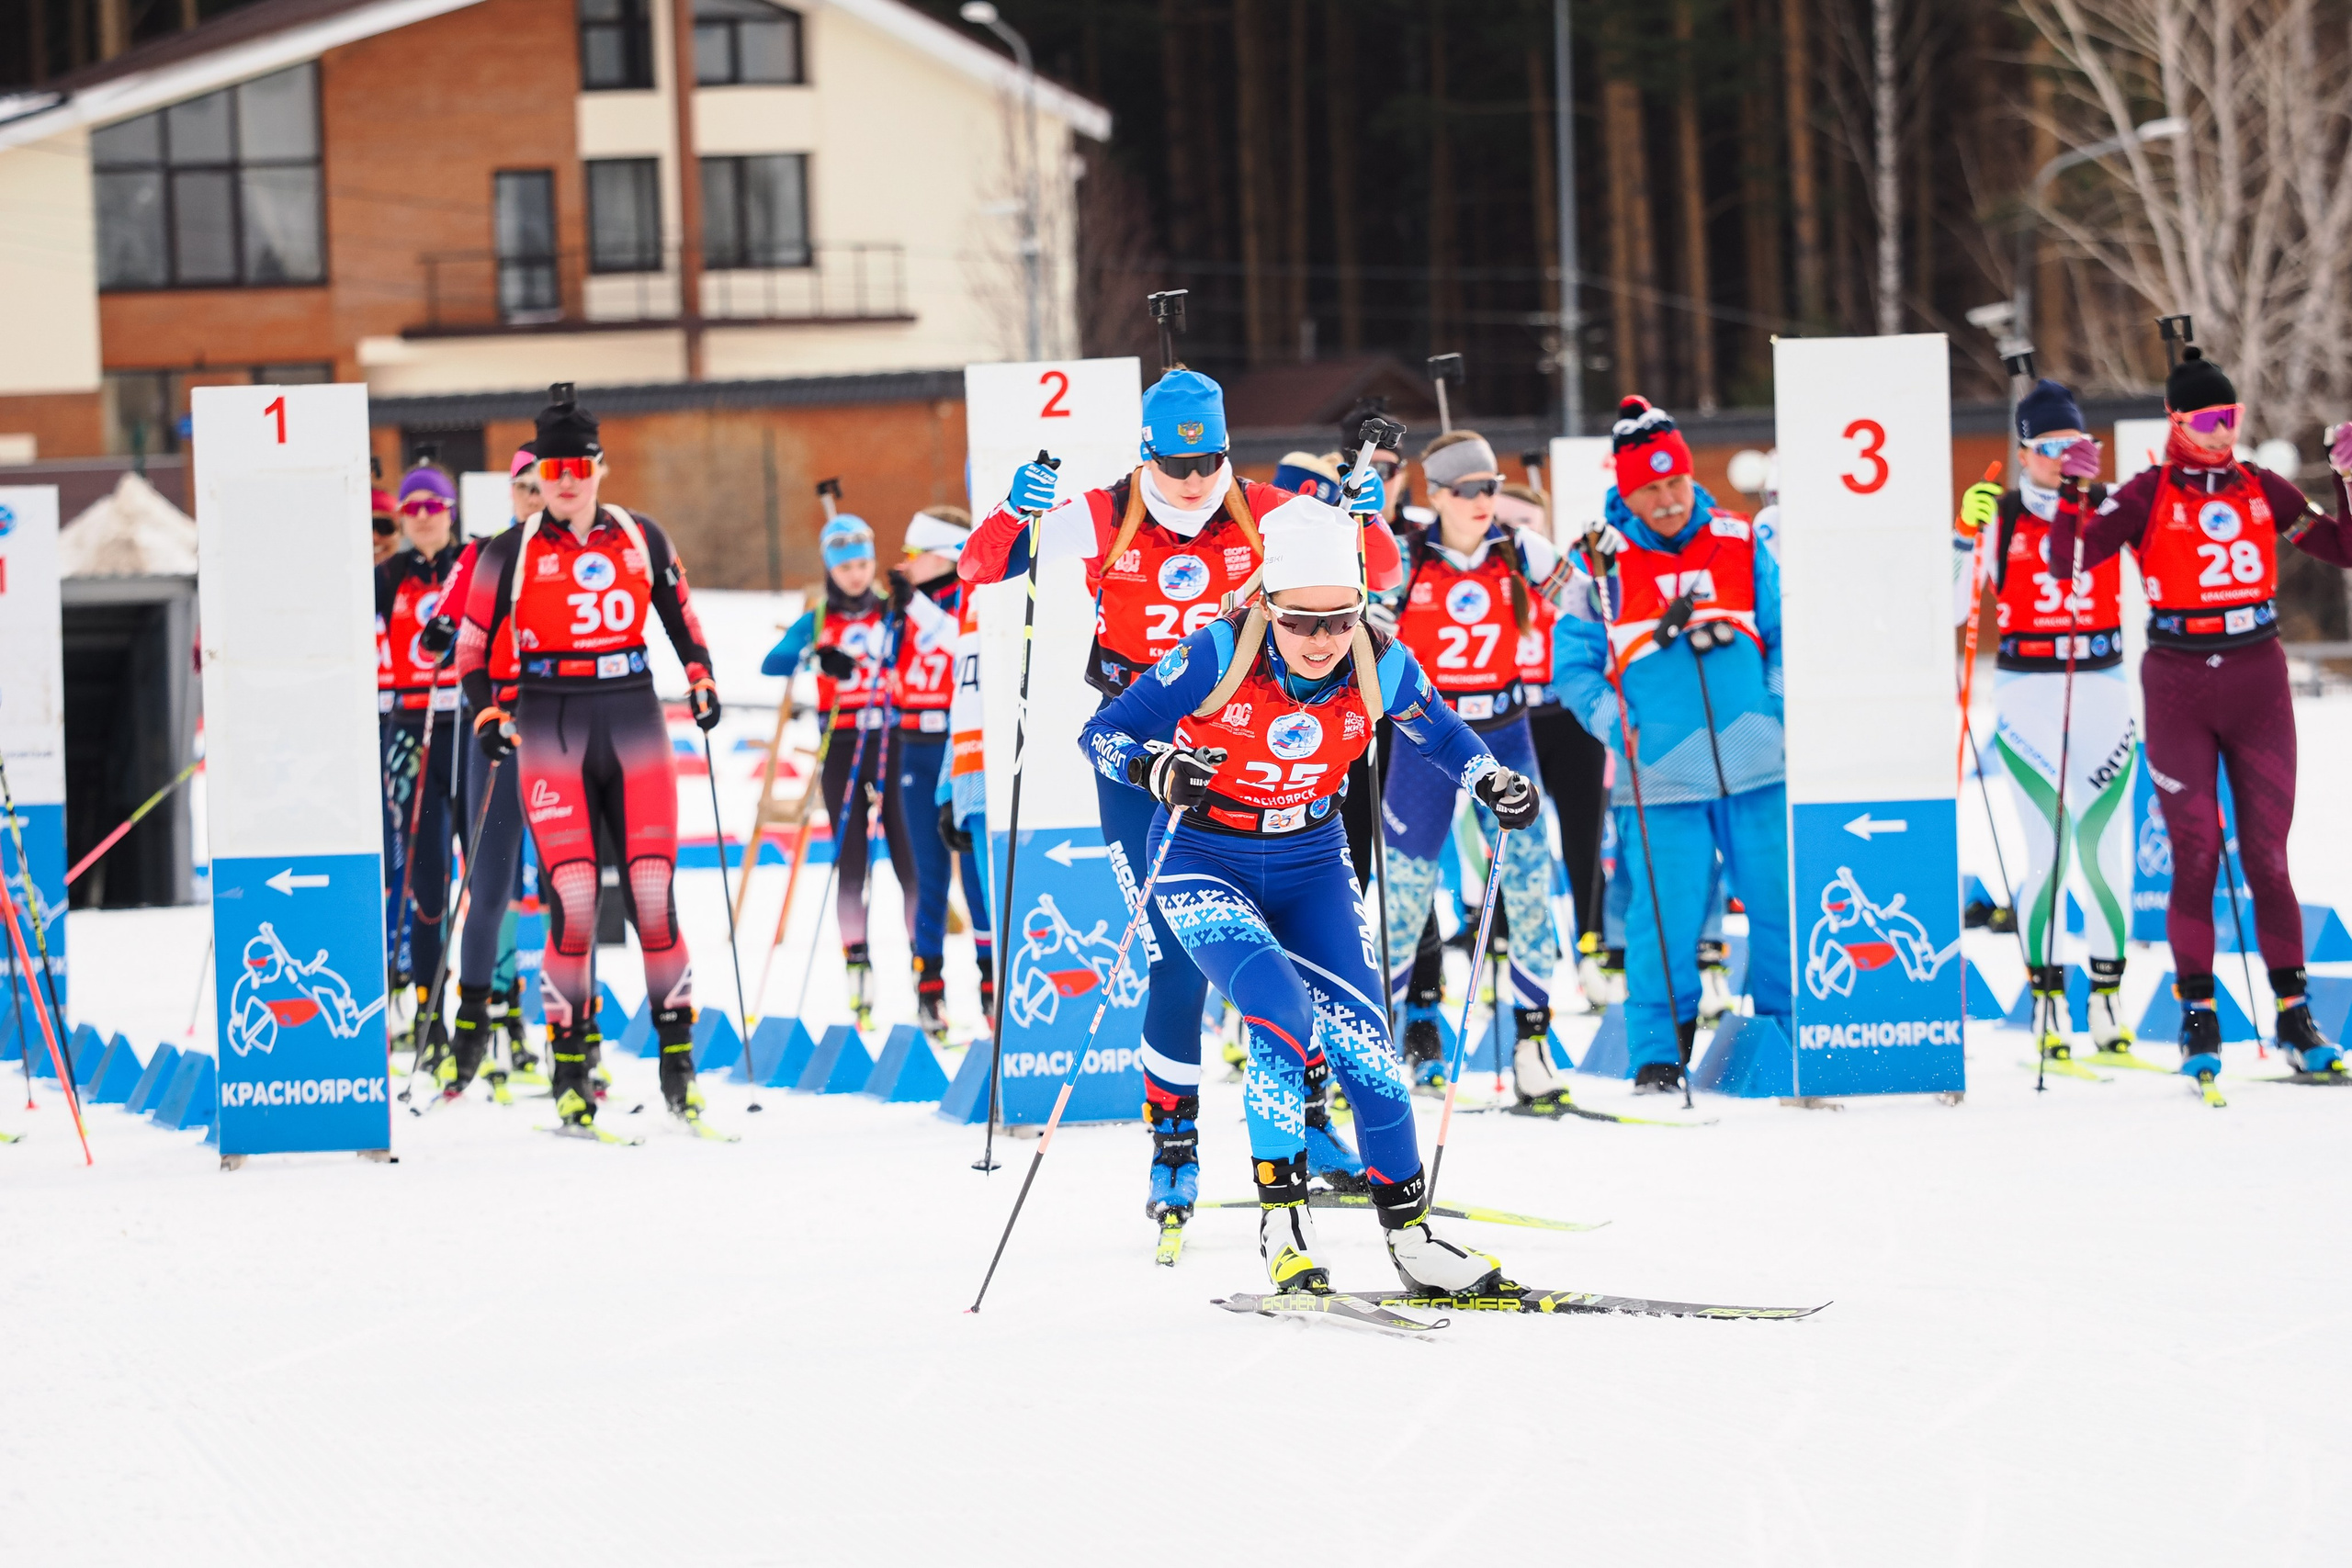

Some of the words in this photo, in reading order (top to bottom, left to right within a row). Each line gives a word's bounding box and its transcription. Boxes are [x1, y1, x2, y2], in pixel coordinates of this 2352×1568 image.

[1038, 370, 1071, 418] 2
[264, 395, 287, 444] 1
[1840, 419, 1889, 494] 3
[2197, 539, 2265, 588] 28
[2032, 571, 2095, 614] 32
[567, 589, 635, 635] 30
[1145, 603, 1221, 641] 26
[1436, 623, 1501, 670] 27
[905, 653, 948, 691] 47
[1091, 732, 1127, 770] ЯМАЛ
[1236, 761, 1329, 793] 25
[1798, 1020, 1962, 1050] КРАСНОЯРСК
[1003, 1047, 1145, 1078] КРАСОЯРС
[221, 1077, 386, 1108] КРАСНОЯРСК
[1403, 1179, 1422, 1197] 175
[1261, 1294, 1317, 1312] FISCHER
